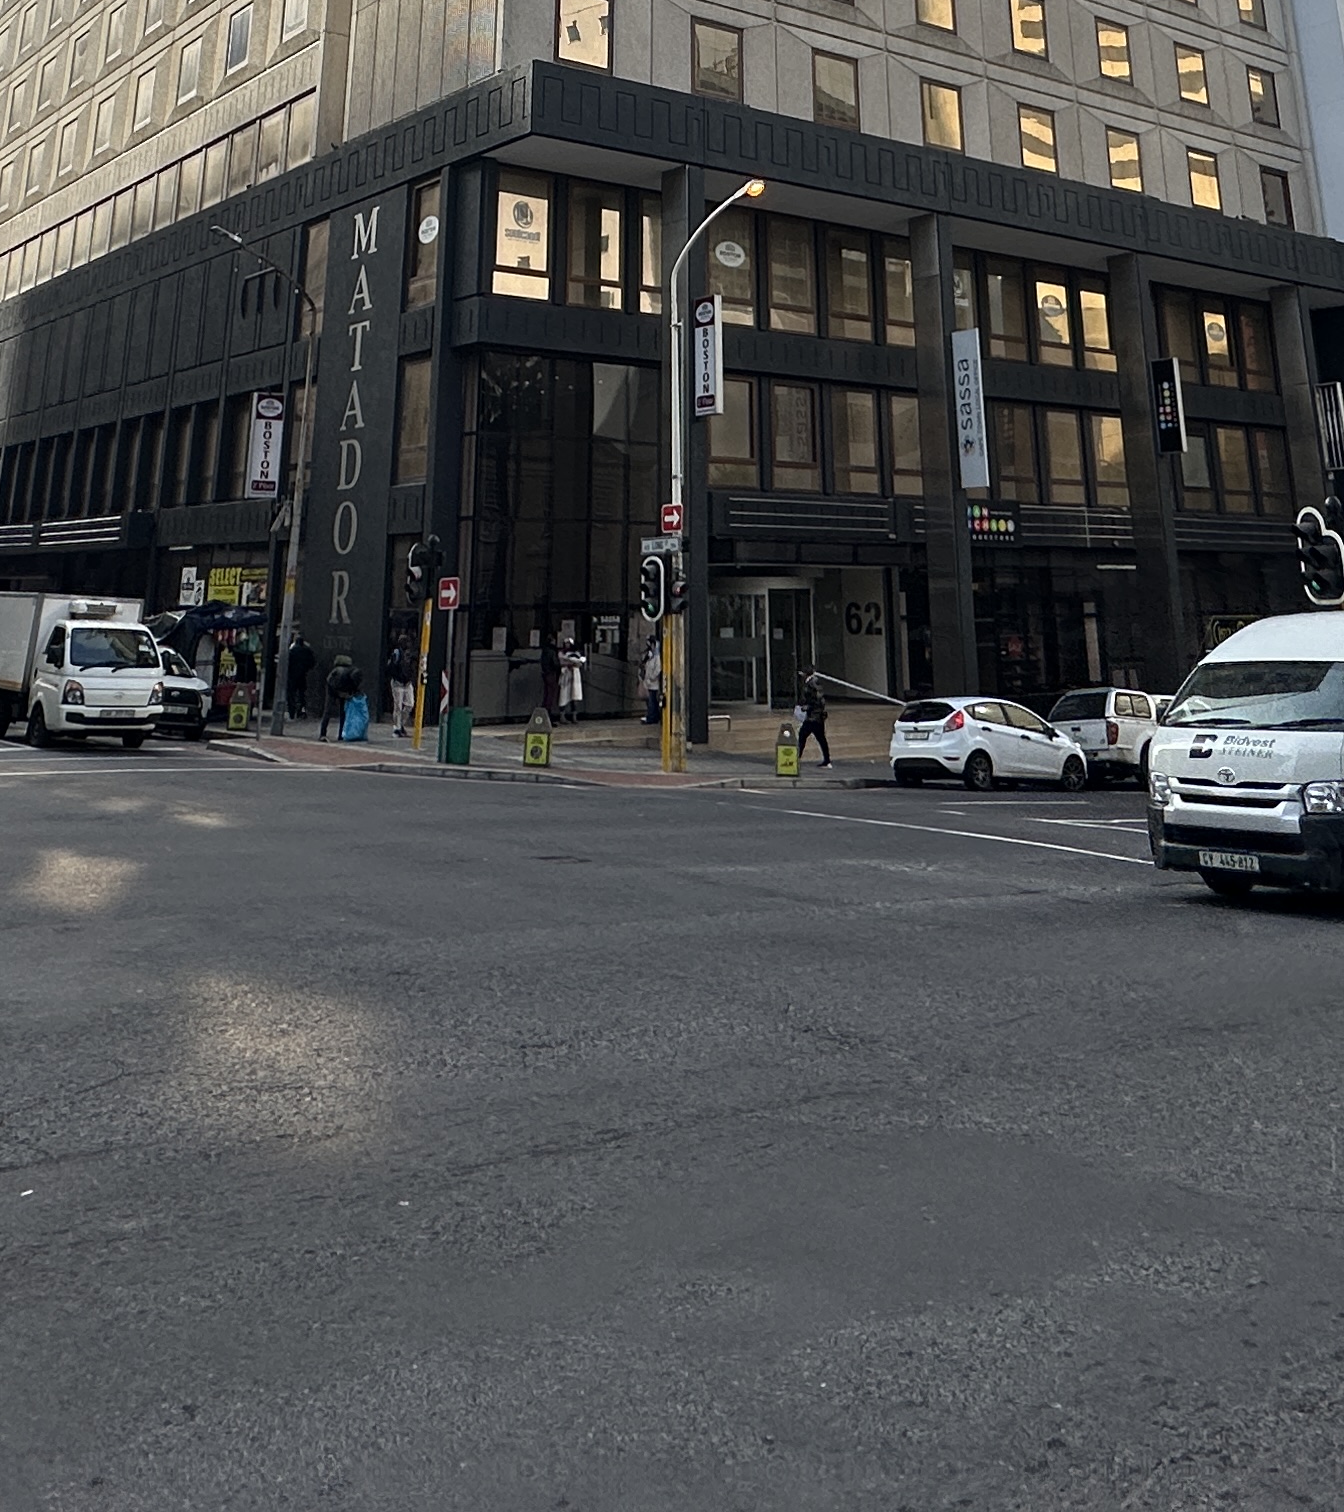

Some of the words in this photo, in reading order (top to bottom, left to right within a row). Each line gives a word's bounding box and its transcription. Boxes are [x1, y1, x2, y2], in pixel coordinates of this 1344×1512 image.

[702, 328, 710, 394] BOSTON
[328, 205, 380, 625] MATADOR
[958, 358, 973, 430] sassa
[259, 421, 272, 479] BOSTON
[209, 567, 242, 586] SELECT
[845, 601, 883, 636] 62
[1223, 735, 1276, 748] Bidvest
